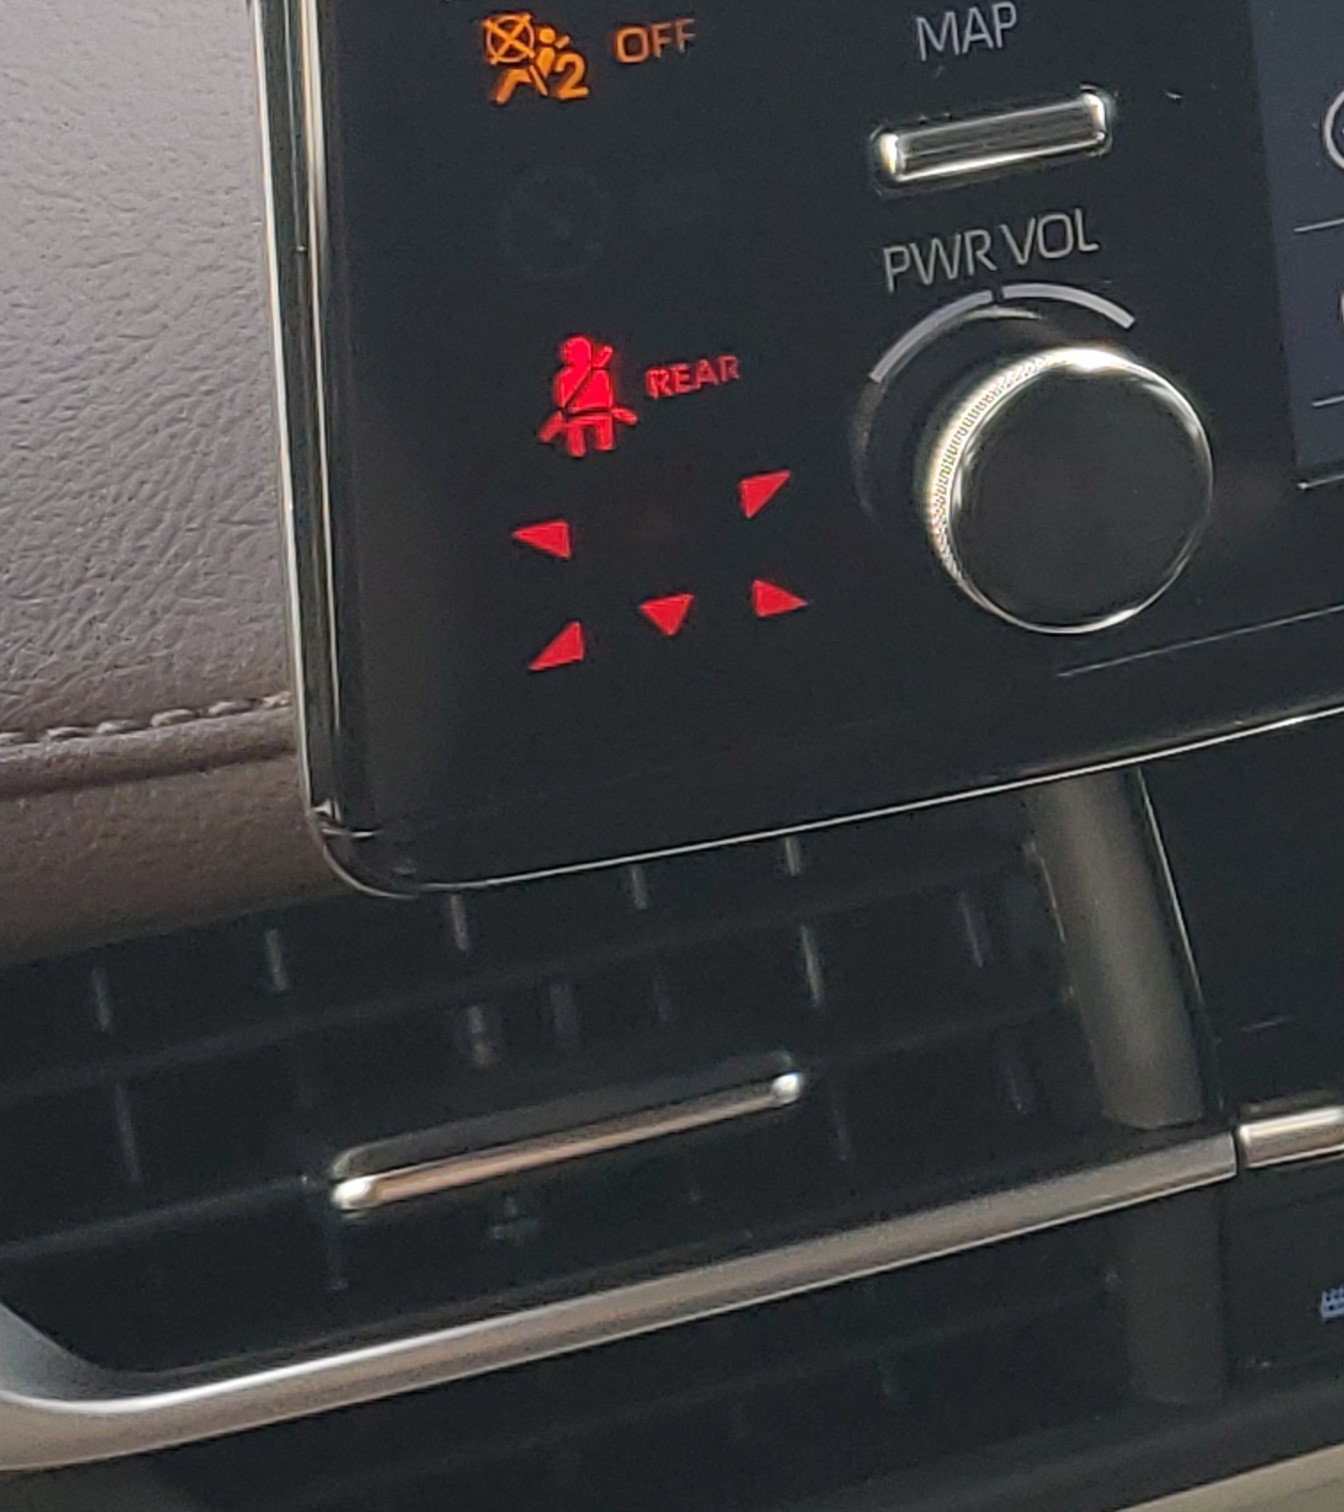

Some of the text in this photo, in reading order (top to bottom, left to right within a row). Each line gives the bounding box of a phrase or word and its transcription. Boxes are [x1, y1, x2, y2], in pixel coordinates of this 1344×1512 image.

[614, 18, 697, 64] OFF
[915, 2, 1019, 61] MAP
[882, 208, 1100, 292] PWR VOL
[645, 354, 740, 400] REAR
